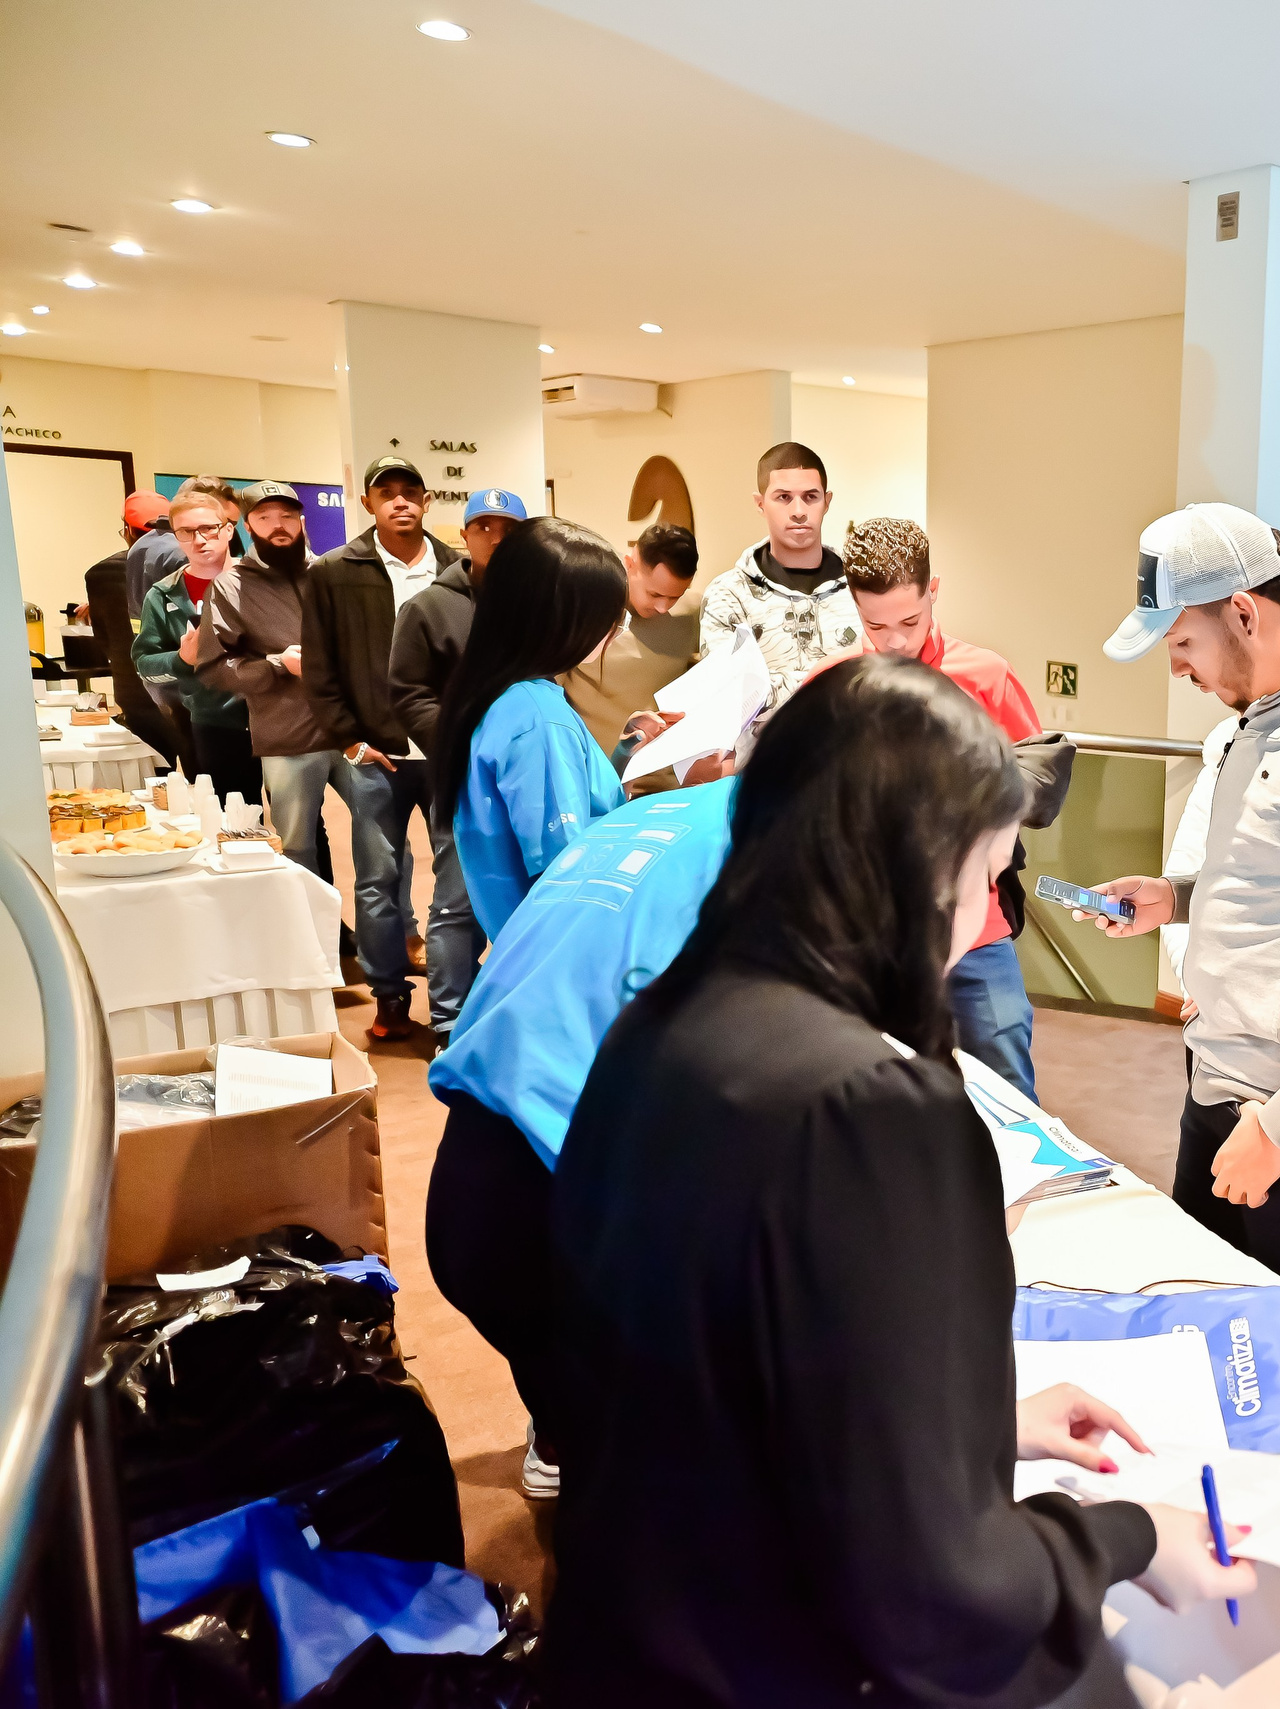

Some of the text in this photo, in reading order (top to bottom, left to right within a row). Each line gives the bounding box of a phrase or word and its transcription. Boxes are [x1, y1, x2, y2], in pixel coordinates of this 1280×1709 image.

[1, 426, 62, 440] ACHECO
[429, 439, 478, 454] SALAS
[446, 465, 466, 478] DE
[426, 489, 469, 502] VENT
